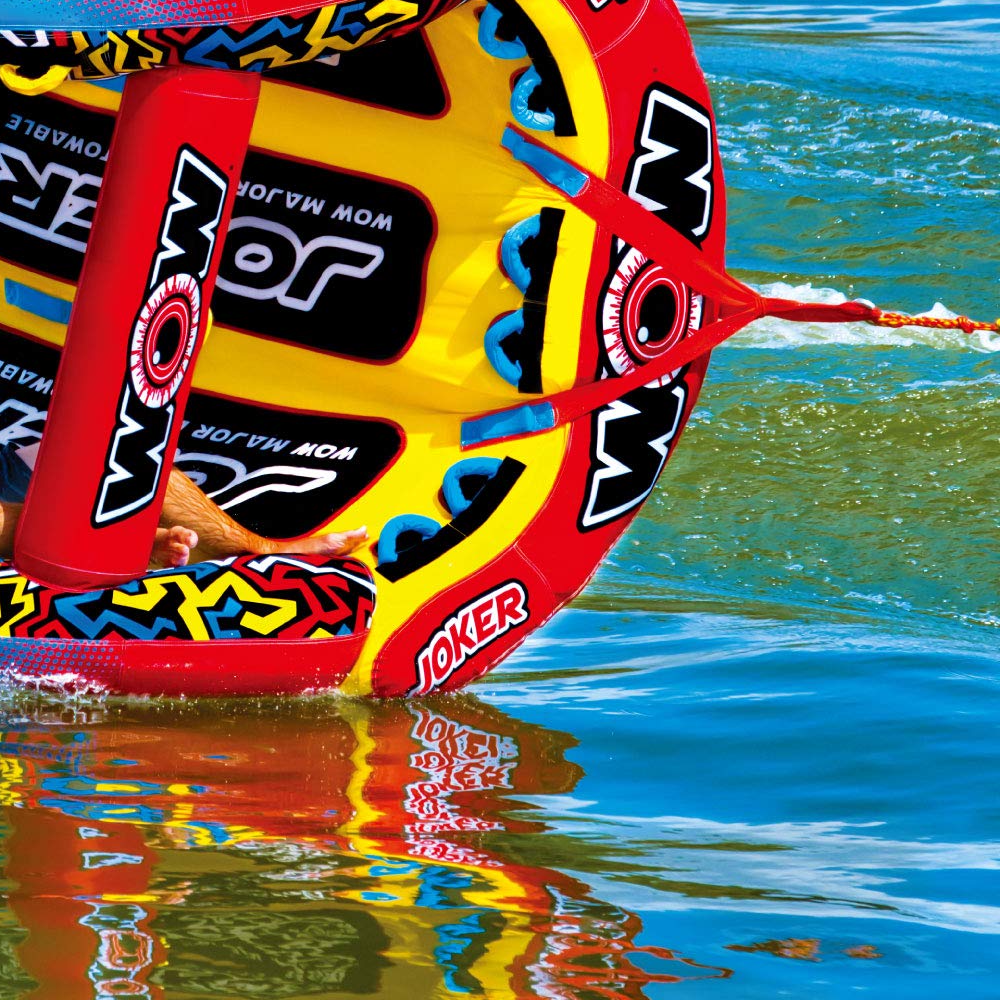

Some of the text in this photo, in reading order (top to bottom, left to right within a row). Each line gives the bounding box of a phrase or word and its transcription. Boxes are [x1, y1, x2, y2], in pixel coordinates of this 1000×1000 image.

[330, 203, 393, 232] WOW
[92, 146, 228, 527] WOW
[190, 424, 291, 453] MAJOR
[290, 441, 359, 461] WOW
[406, 580, 529, 698] JOKER
